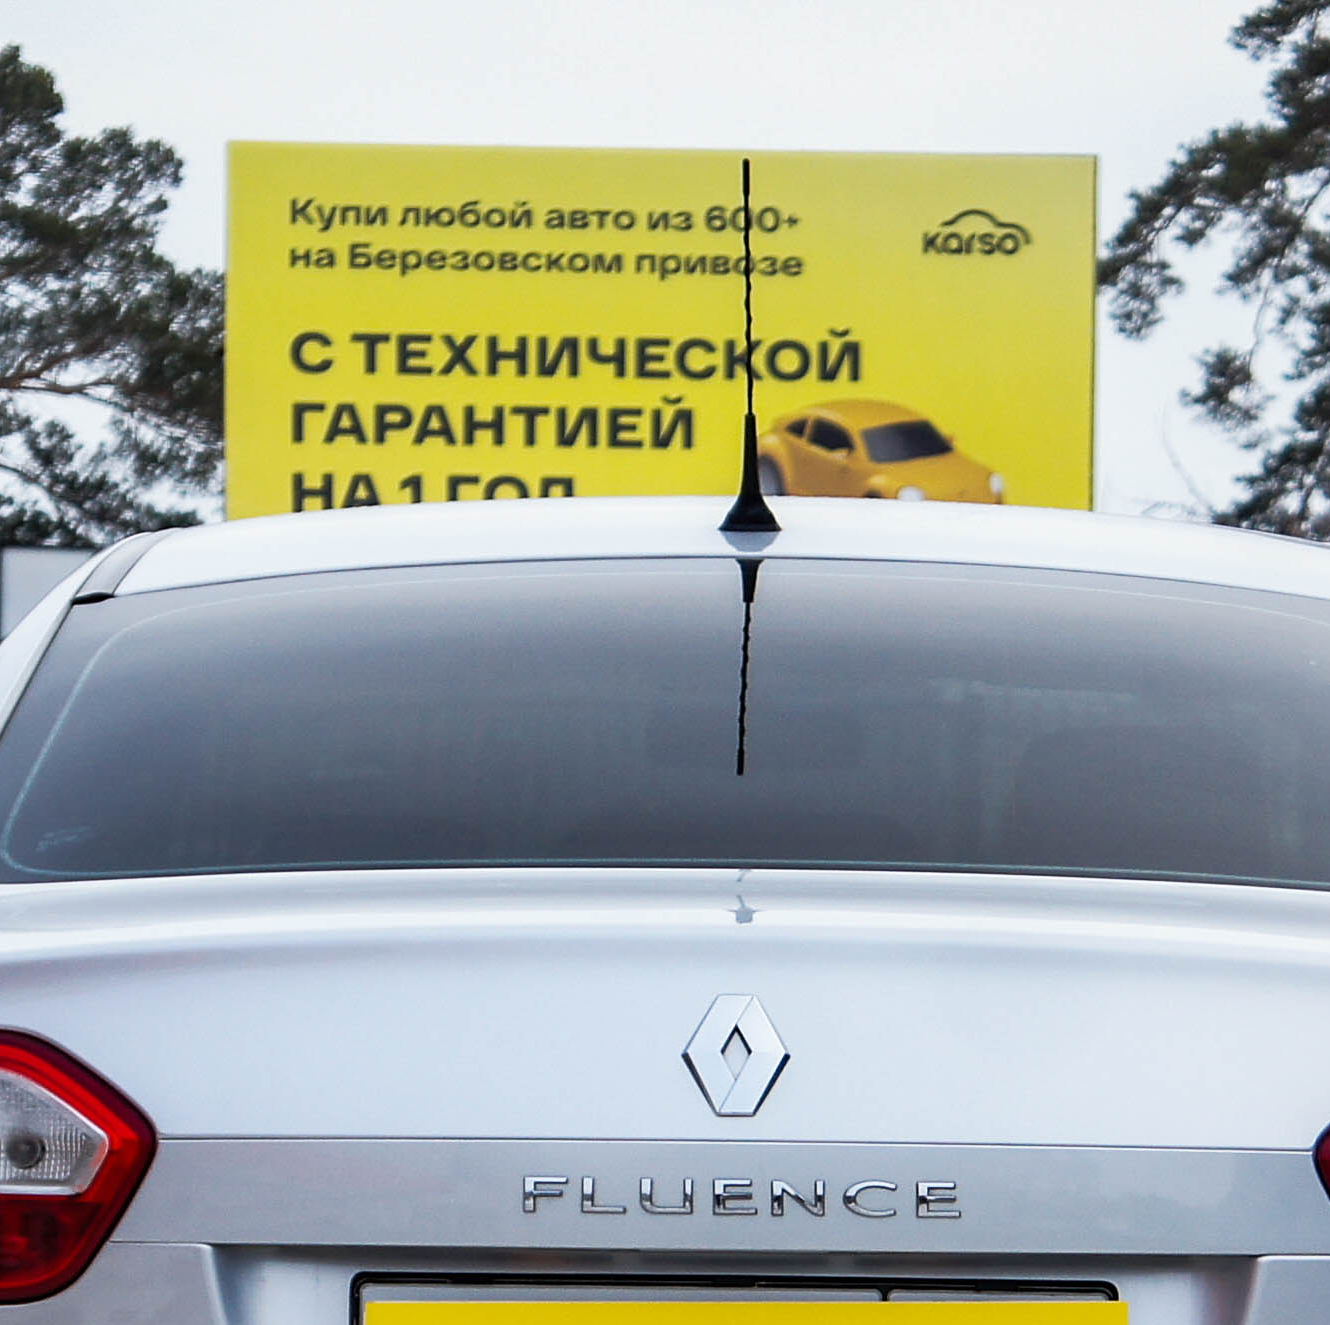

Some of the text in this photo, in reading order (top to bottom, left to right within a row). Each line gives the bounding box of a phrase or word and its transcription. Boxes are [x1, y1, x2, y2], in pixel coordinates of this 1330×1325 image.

[290, 198, 800, 233] Купи любой авто из 600+
[289, 242, 804, 282] на Березовском привозе
[291, 327, 861, 383] С ТЕХНИЧЕСКОЙ
[292, 396, 693, 450] ГАРАНТИЕЙ
[292, 472, 381, 513] НА
[399, 475, 423, 504] 1
[521, 1174, 963, 1220] FLUENCE
